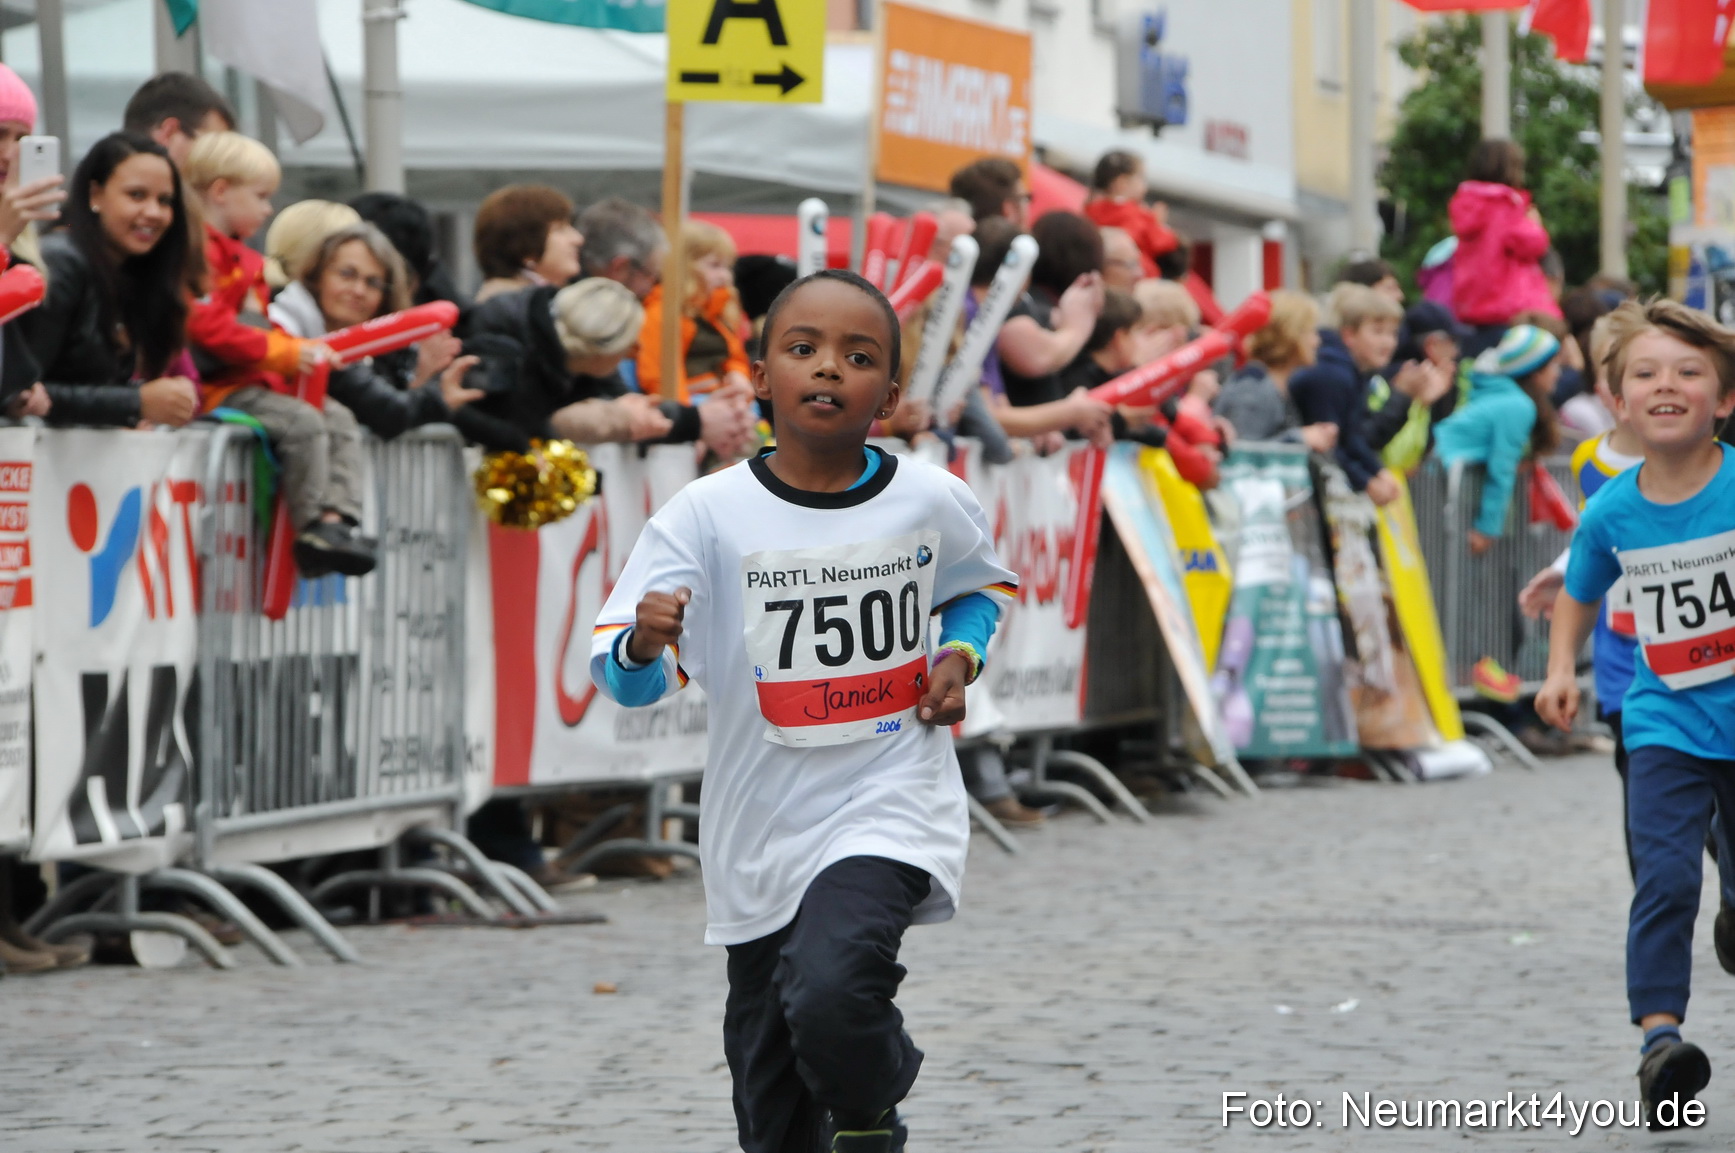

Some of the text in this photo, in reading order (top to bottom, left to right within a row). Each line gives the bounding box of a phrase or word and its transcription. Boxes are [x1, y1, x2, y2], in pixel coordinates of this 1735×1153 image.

[702, 0, 789, 46] A
[747, 555, 912, 588] PARTL Neumarkt
[1627, 562, 1669, 578] PARTL
[764, 580, 920, 669] 7500
[875, 718, 902, 735] 2006
